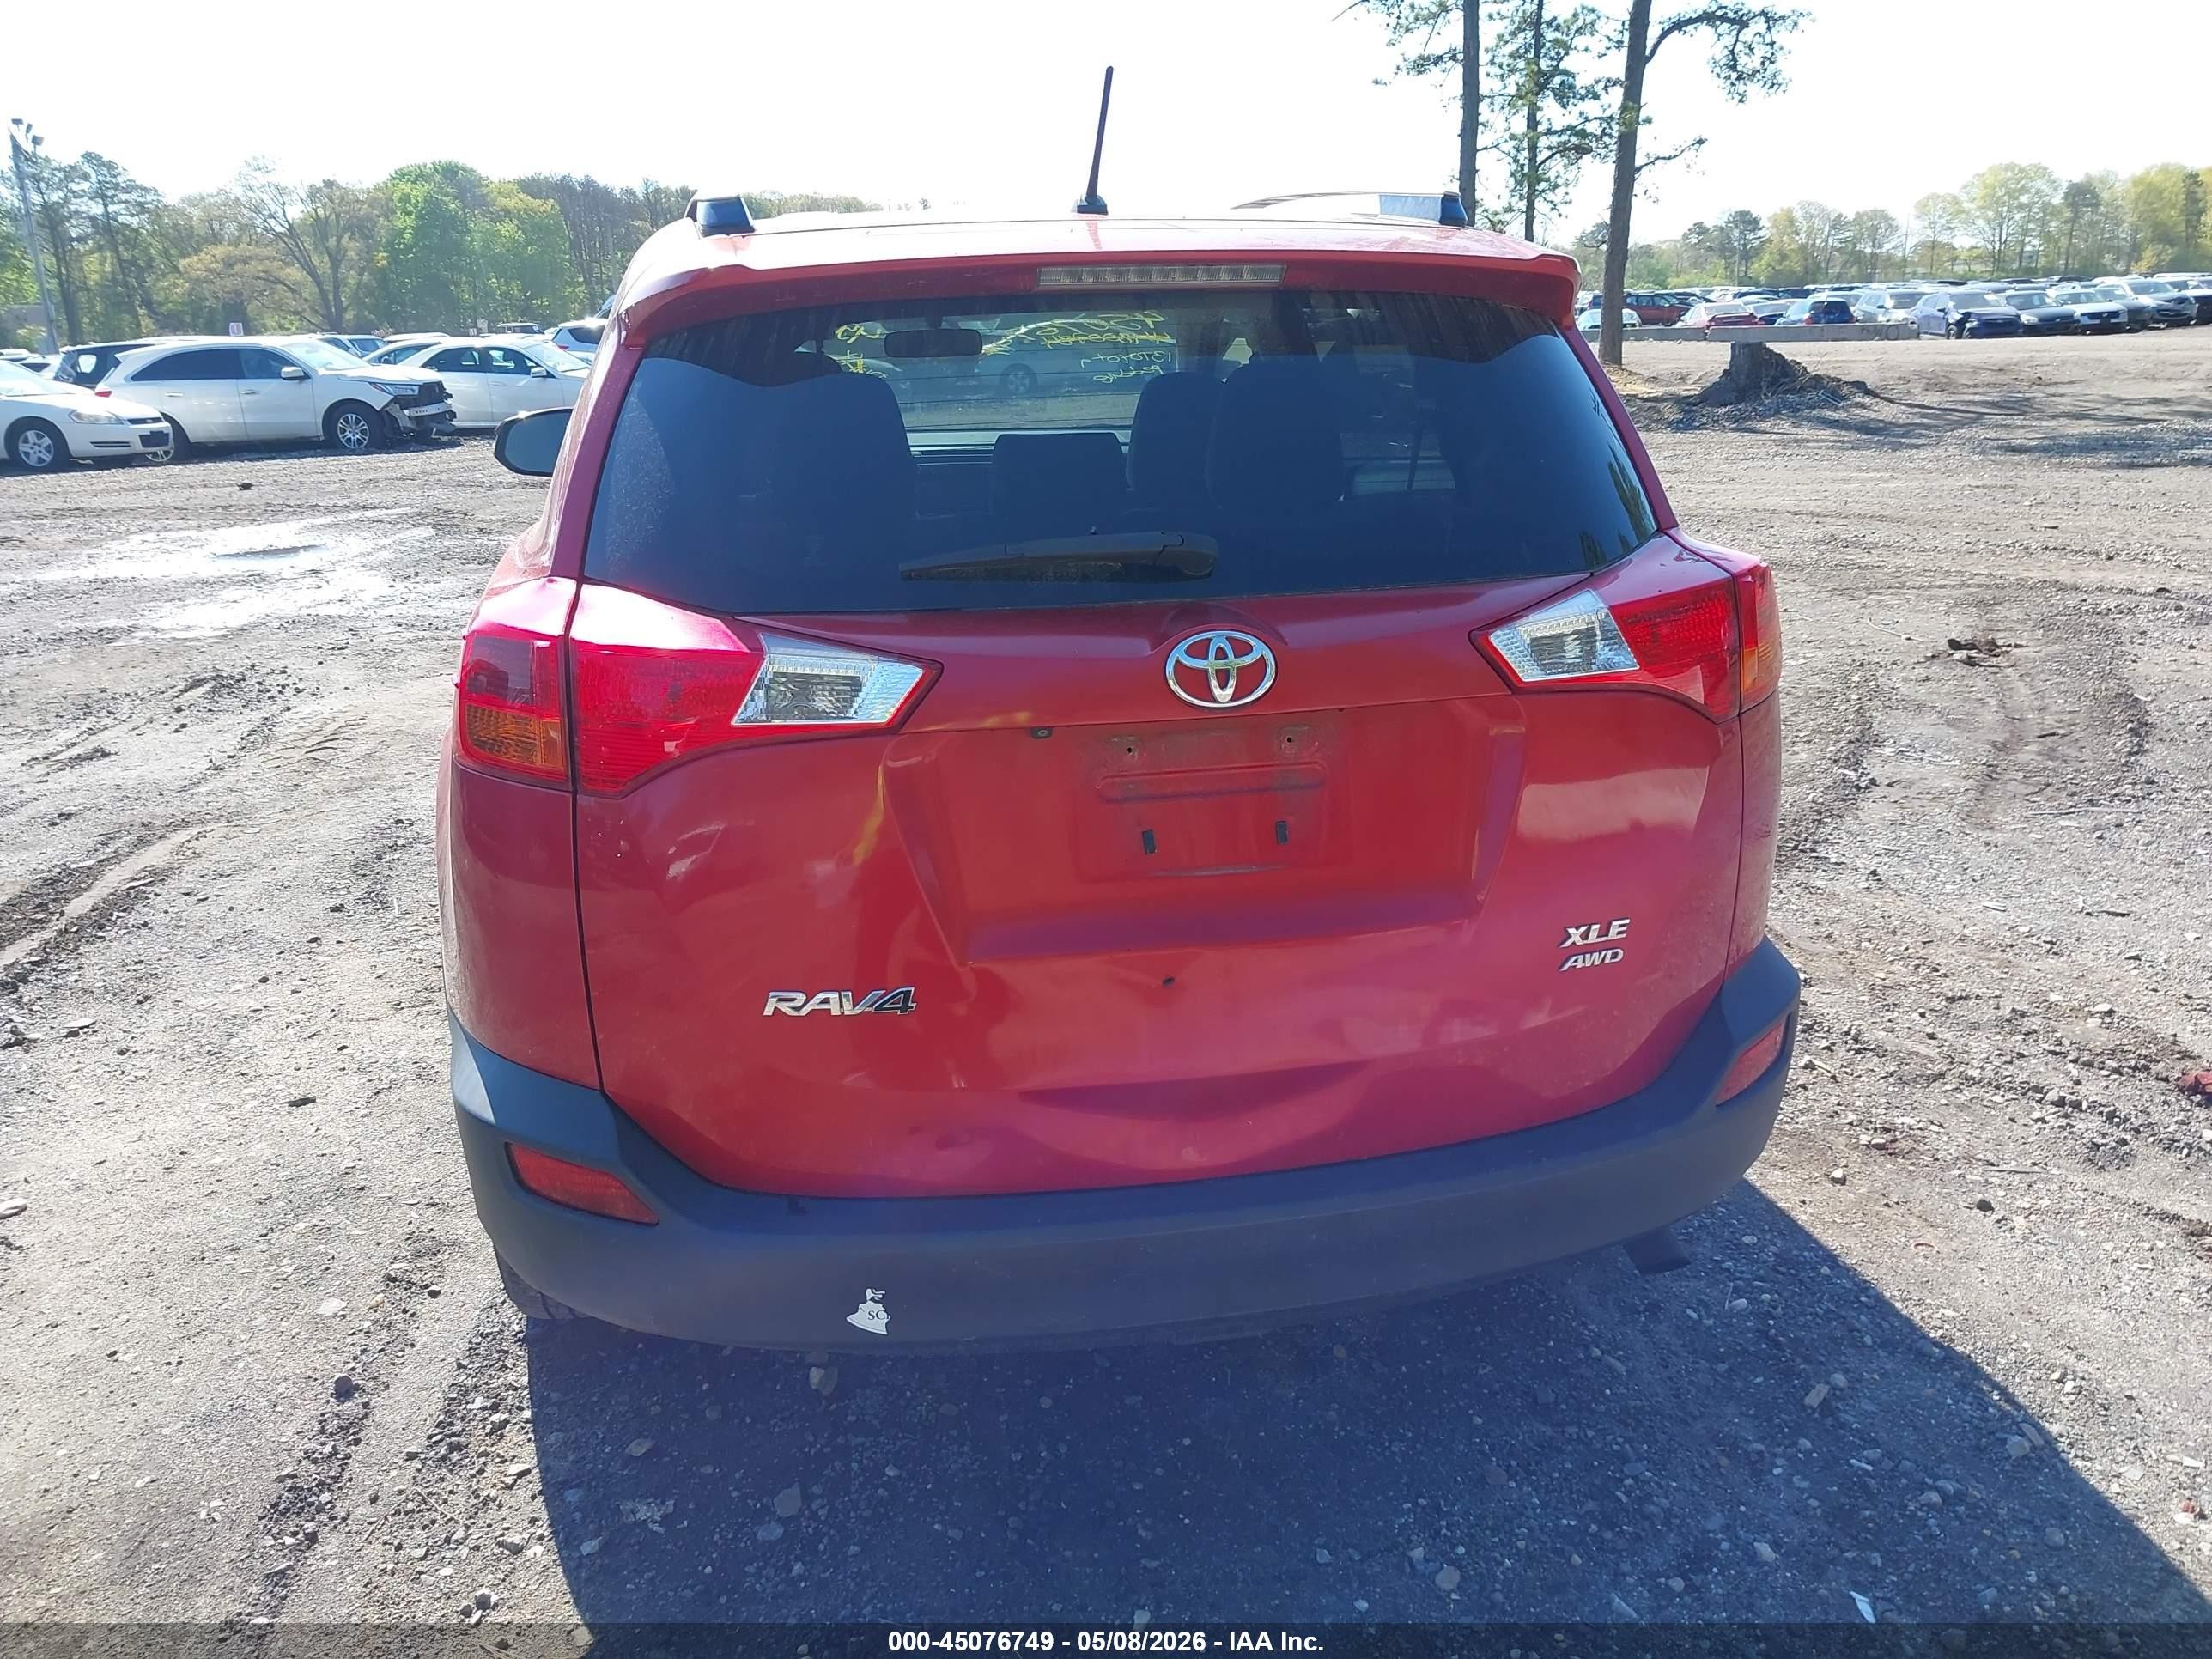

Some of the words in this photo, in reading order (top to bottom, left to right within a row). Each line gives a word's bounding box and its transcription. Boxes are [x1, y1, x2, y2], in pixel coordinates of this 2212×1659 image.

[1559, 918, 1631, 948] XLE
[1559, 948, 1624, 972] AWD
[762, 987, 917, 1017] RAV4
